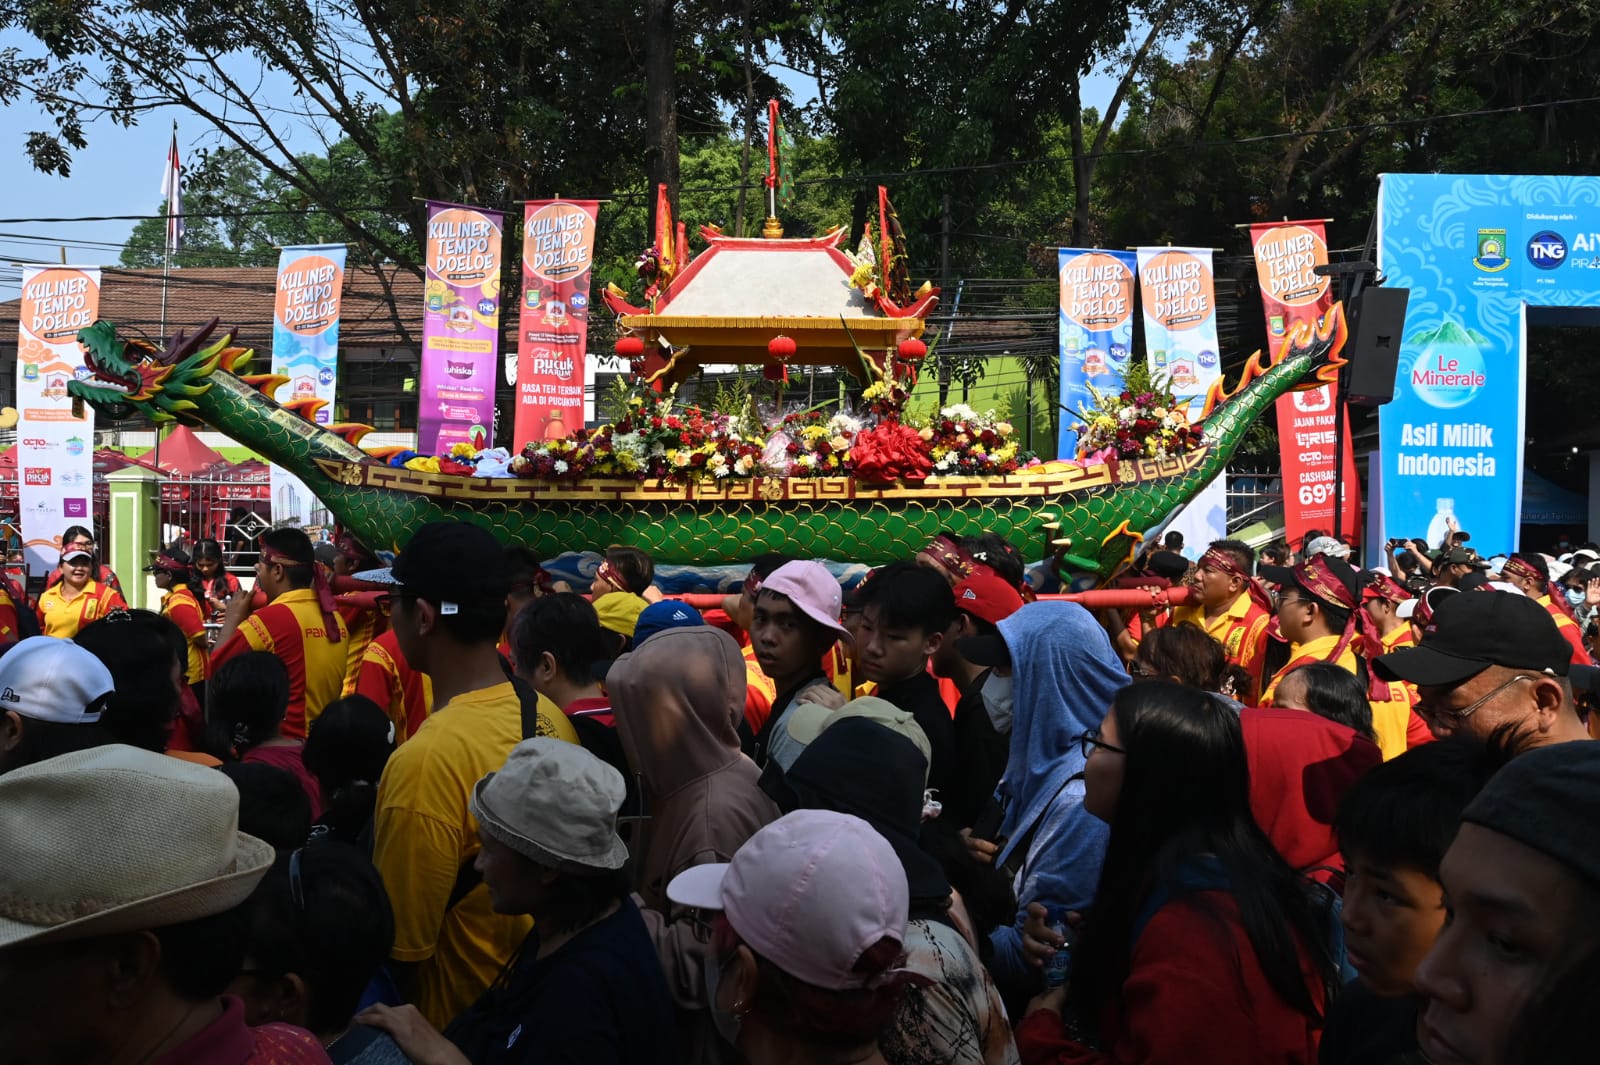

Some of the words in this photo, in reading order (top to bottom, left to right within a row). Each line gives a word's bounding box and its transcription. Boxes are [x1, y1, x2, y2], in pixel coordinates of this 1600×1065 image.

[429, 221, 491, 239] KULINER
[528, 212, 586, 238] KULINER
[436, 237, 488, 256] TEMPO
[535, 231, 582, 253] TEMPO
[1257, 233, 1315, 263] KULINER
[1530, 244, 1565, 259] TNG
[436, 252, 494, 273] DOELOE
[534, 246, 588, 270] DOELOE
[1267, 251, 1315, 279] TEMPO
[280, 264, 335, 291] KULINER
[1063, 264, 1124, 286] KULINER
[1143, 261, 1202, 286] KULINER
[1269, 271, 1323, 295] DOELOE
[26, 277, 88, 300] KULINER
[286, 284, 332, 307] TEMPO
[1072, 282, 1120, 300] TEMPO
[1153, 279, 1201, 301] TEMPO
[34, 295, 85, 315] TEMPO
[479, 303, 495, 312] TNG
[570, 296, 587, 305] TNG
[1071, 297, 1126, 318] DOELOE
[1154, 294, 1208, 319] DOELOE
[32, 309, 91, 332] DOELOE
[284, 299, 337, 325] DOELOE
[531, 347, 550, 358] Teh
[1110, 346, 1126, 357] TNG
[1199, 354, 1216, 364] TNG
[1438, 355, 1458, 371] Le
[1412, 370, 1486, 386] Minerale
[521, 383, 540, 393] RASA
[542, 384, 556, 394] TEH
[557, 385, 582, 396] TERBAIK
[522, 395, 537, 404] ADA
[538, 395, 547, 405] DI
[548, 396, 581, 408] PUCUKNYA
[1294, 416, 1315, 427] JAJAN
[23, 438, 46, 446] OCTO
[1401, 423, 1437, 446] Asli
[1443, 423, 1494, 447] Milik
[1299, 451, 1322, 462] OCTO
[1398, 453, 1496, 477] Indonesia
